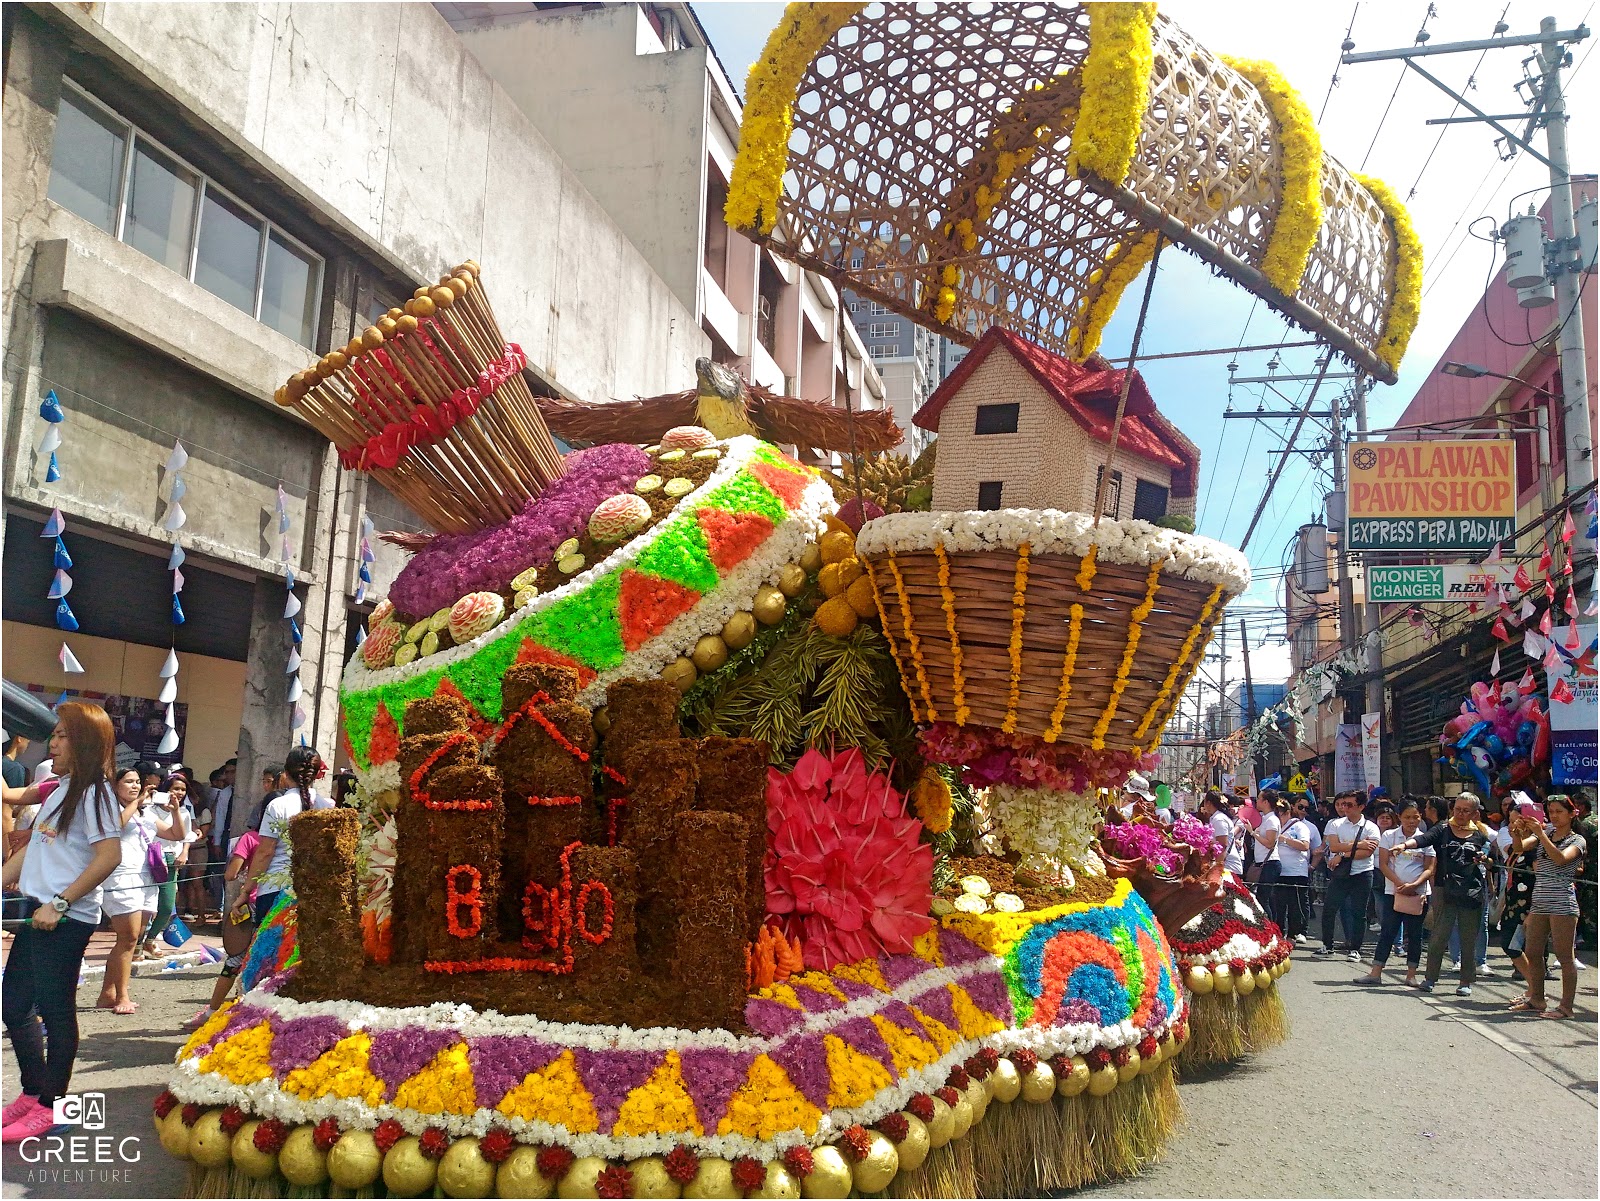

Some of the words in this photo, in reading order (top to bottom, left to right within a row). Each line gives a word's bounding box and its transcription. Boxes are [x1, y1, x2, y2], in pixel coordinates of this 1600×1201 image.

[1377, 446, 1510, 478] PALAWAN
[1353, 481, 1511, 512] PAWNSHOP
[1351, 520, 1415, 544] EXPRESS
[1418, 521, 1456, 544] PERA
[1460, 519, 1512, 543] PADALA
[1372, 569, 1441, 583] MONEY
[1373, 584, 1442, 597] CHANGER
